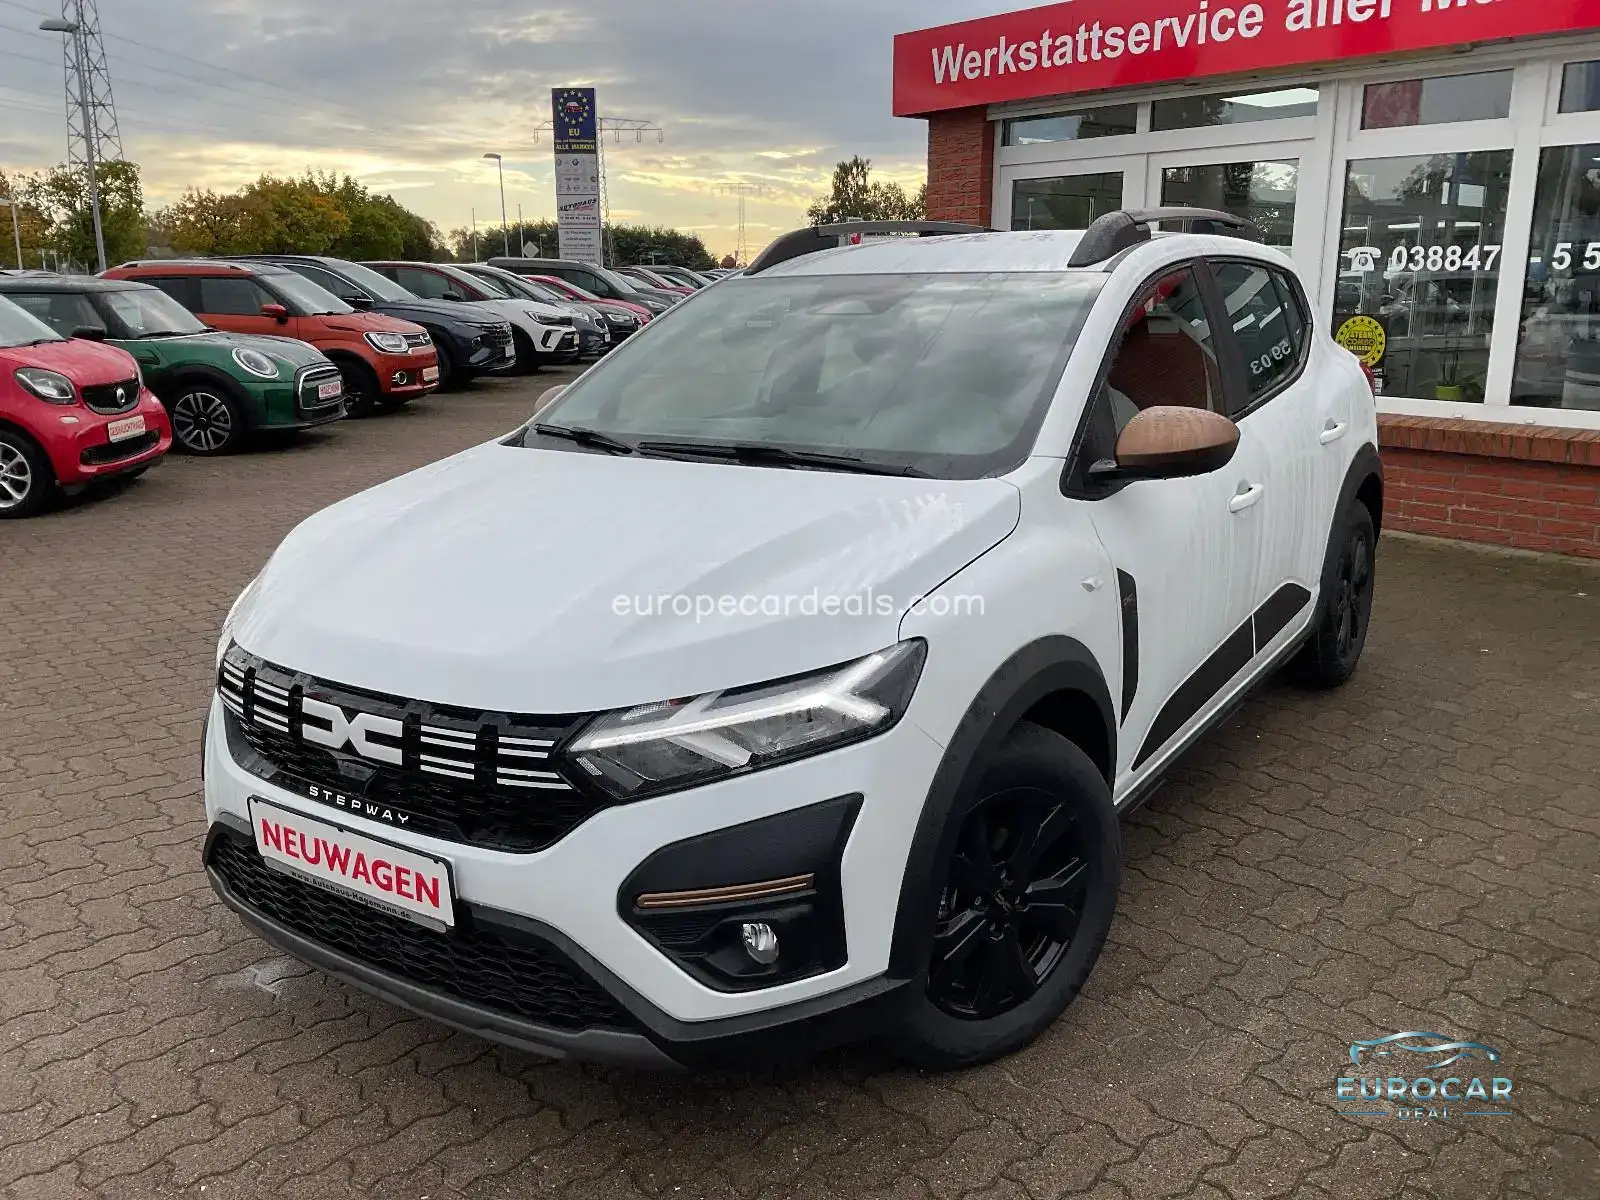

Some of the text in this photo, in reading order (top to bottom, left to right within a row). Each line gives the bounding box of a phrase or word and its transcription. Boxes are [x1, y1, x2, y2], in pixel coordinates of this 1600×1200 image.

[932, 0, 1264, 84] Werkstattservice
[568, 128, 580, 136] EU
[1391, 245, 1502, 271] 038847
[309, 785, 409, 824] STEPWAY
[261, 818, 440, 909] NEUWAGEN
